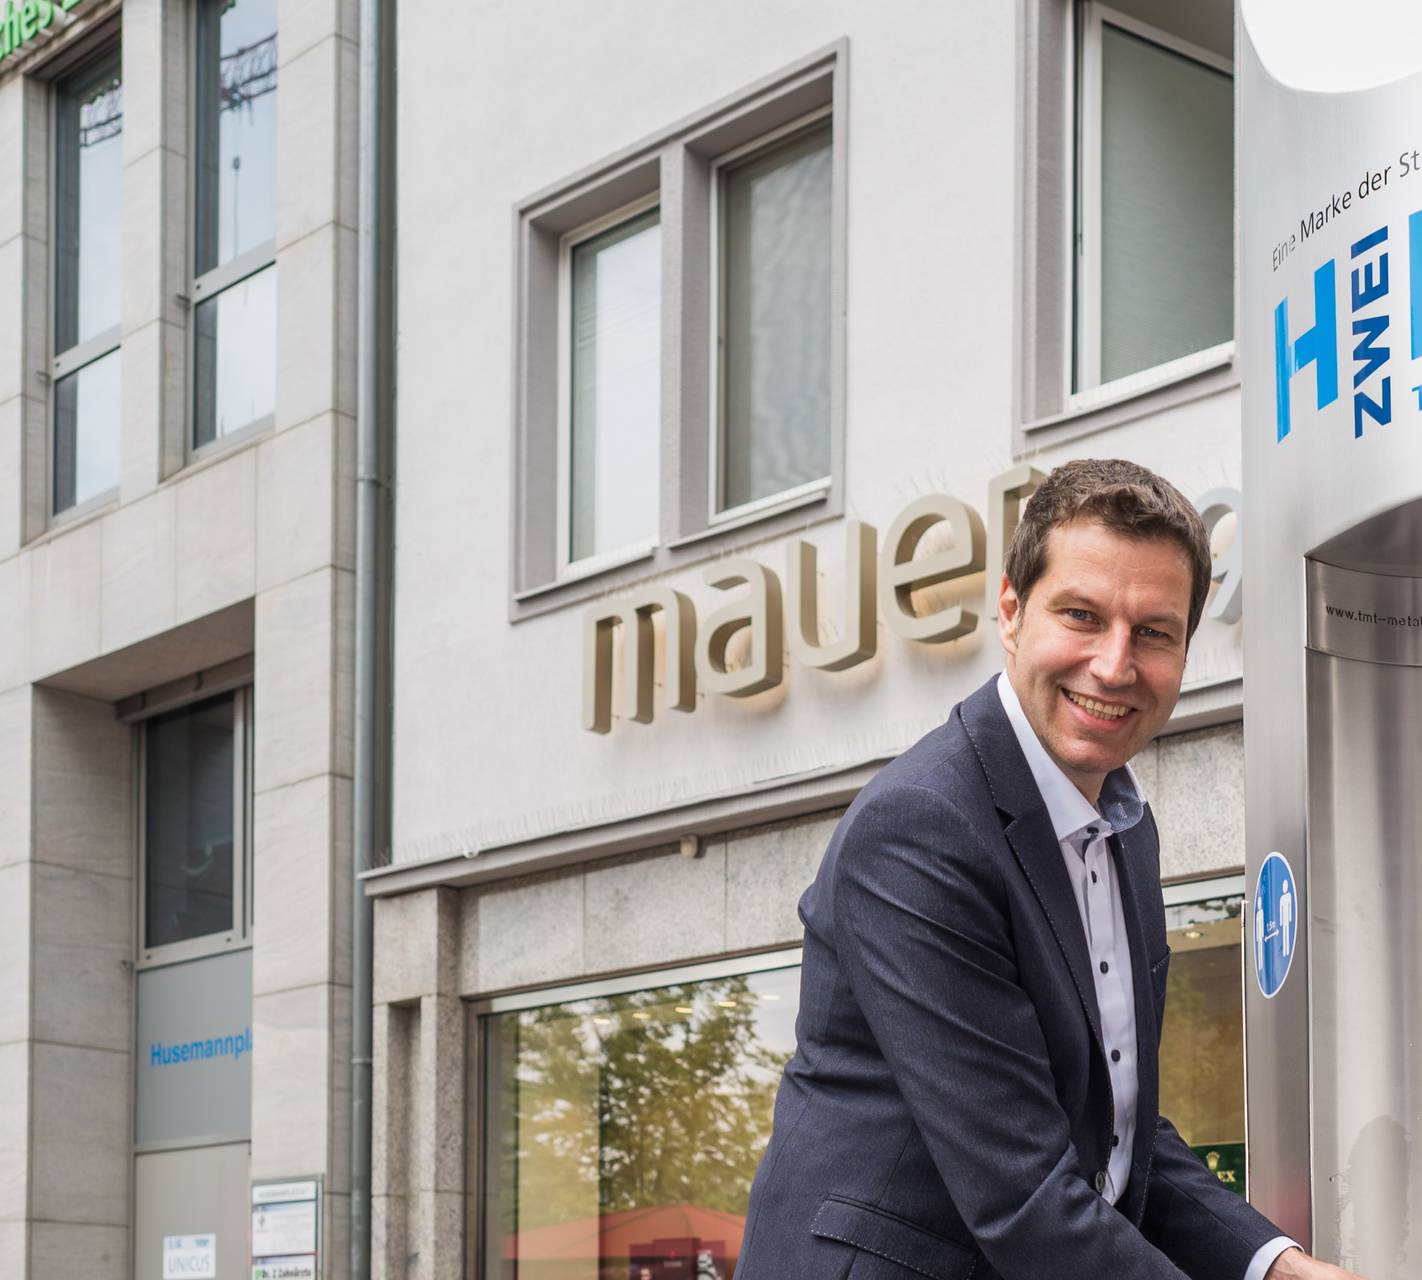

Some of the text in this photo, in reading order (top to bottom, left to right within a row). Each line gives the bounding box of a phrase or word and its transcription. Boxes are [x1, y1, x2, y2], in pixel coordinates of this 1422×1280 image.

[1271, 232, 1296, 273] Eine
[1299, 191, 1352, 244] Marke
[1357, 163, 1392, 201] der
[1350, 225, 1392, 440] ZWEI
